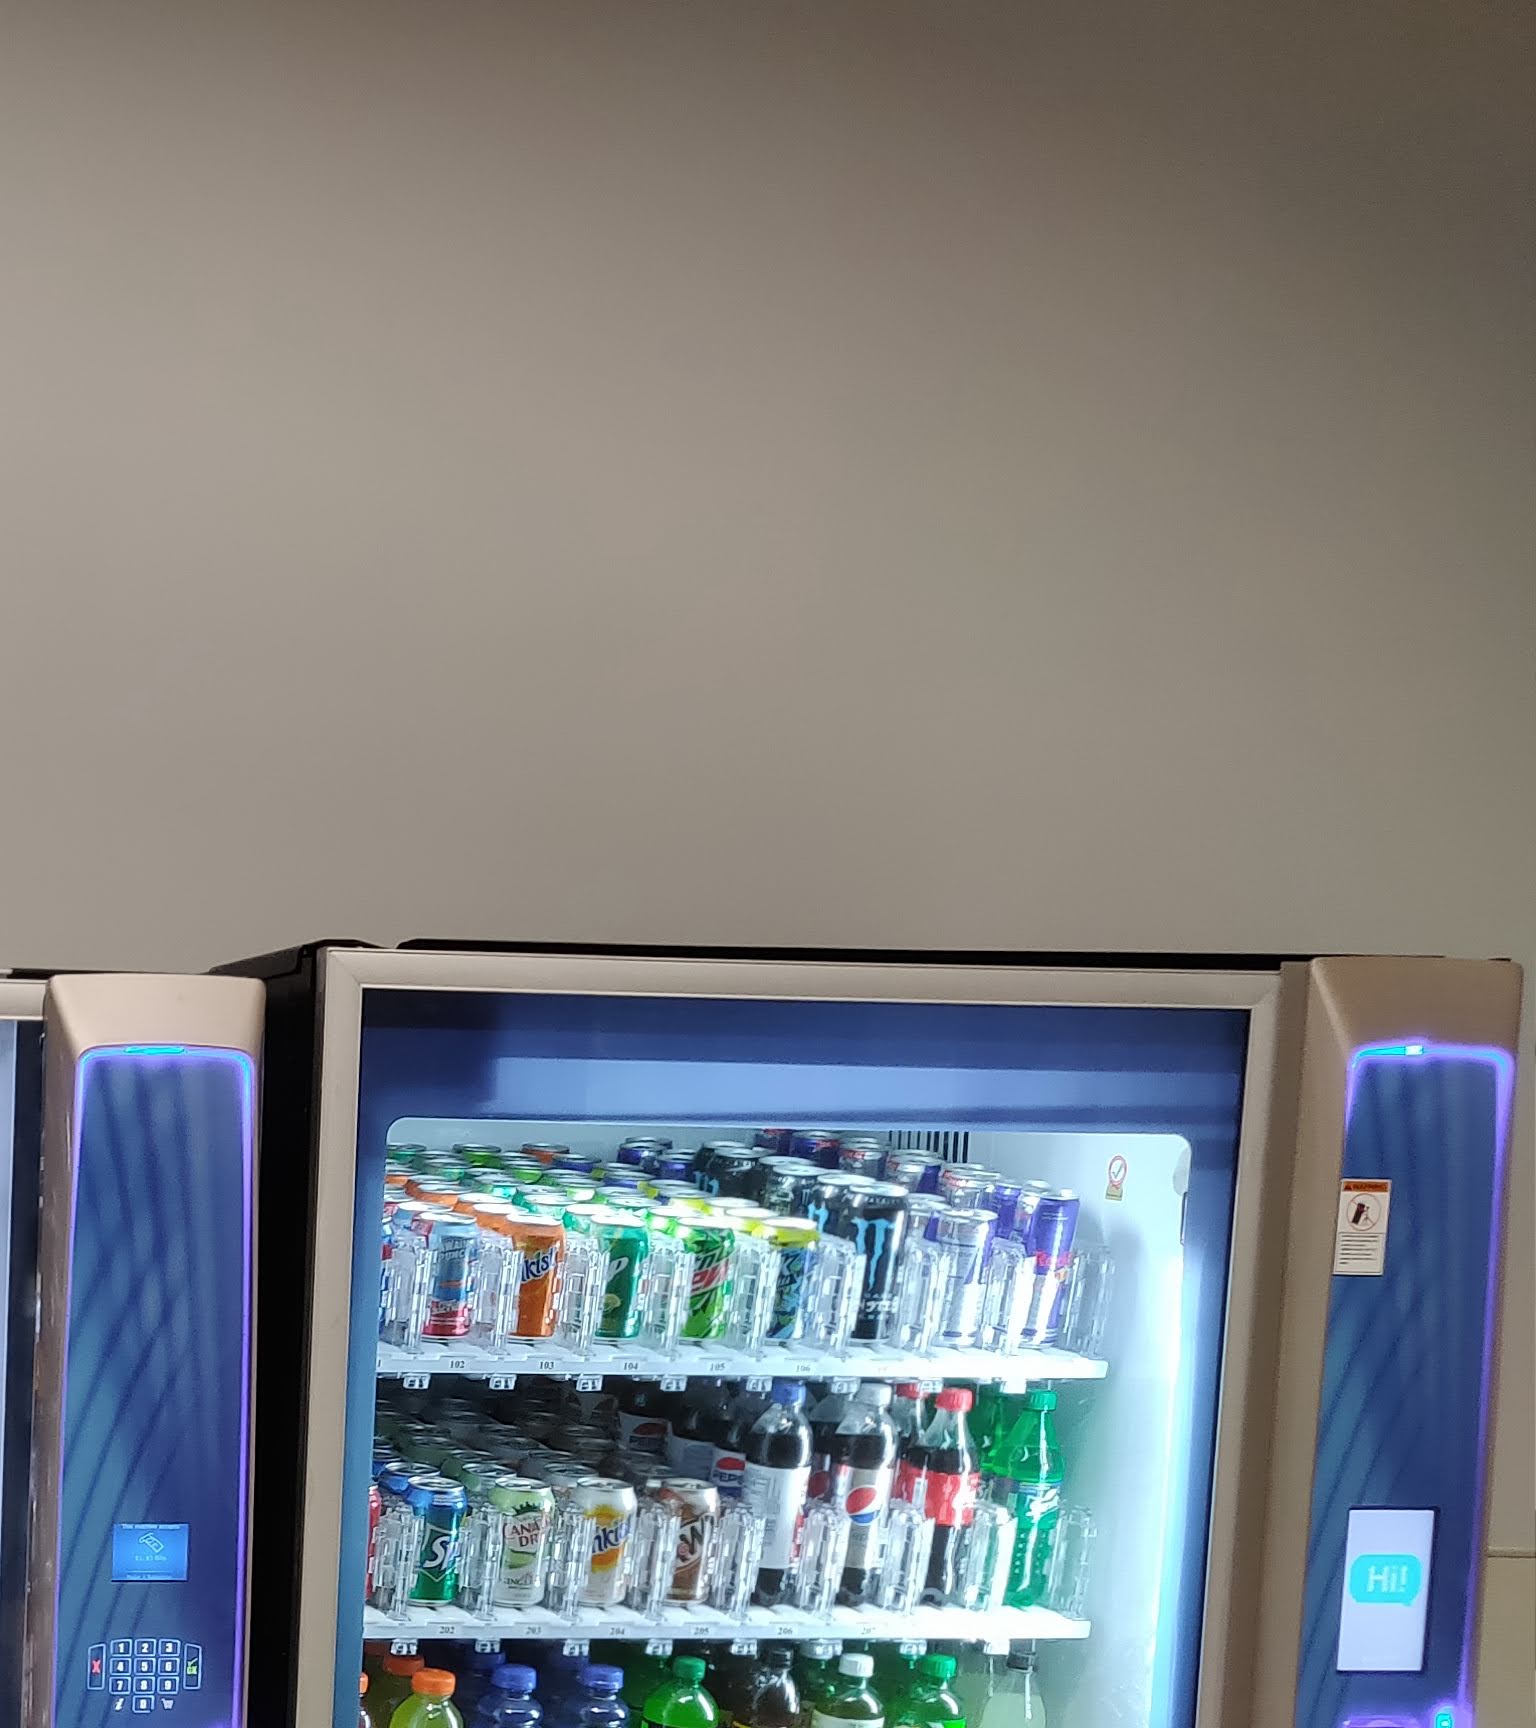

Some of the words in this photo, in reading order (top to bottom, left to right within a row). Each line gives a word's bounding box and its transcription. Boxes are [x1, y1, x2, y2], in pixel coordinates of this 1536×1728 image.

[450, 1360, 465, 1369] 102
[539, 1361, 555, 1370] 103
[1367, 1565, 1408, 1593] Hi!
